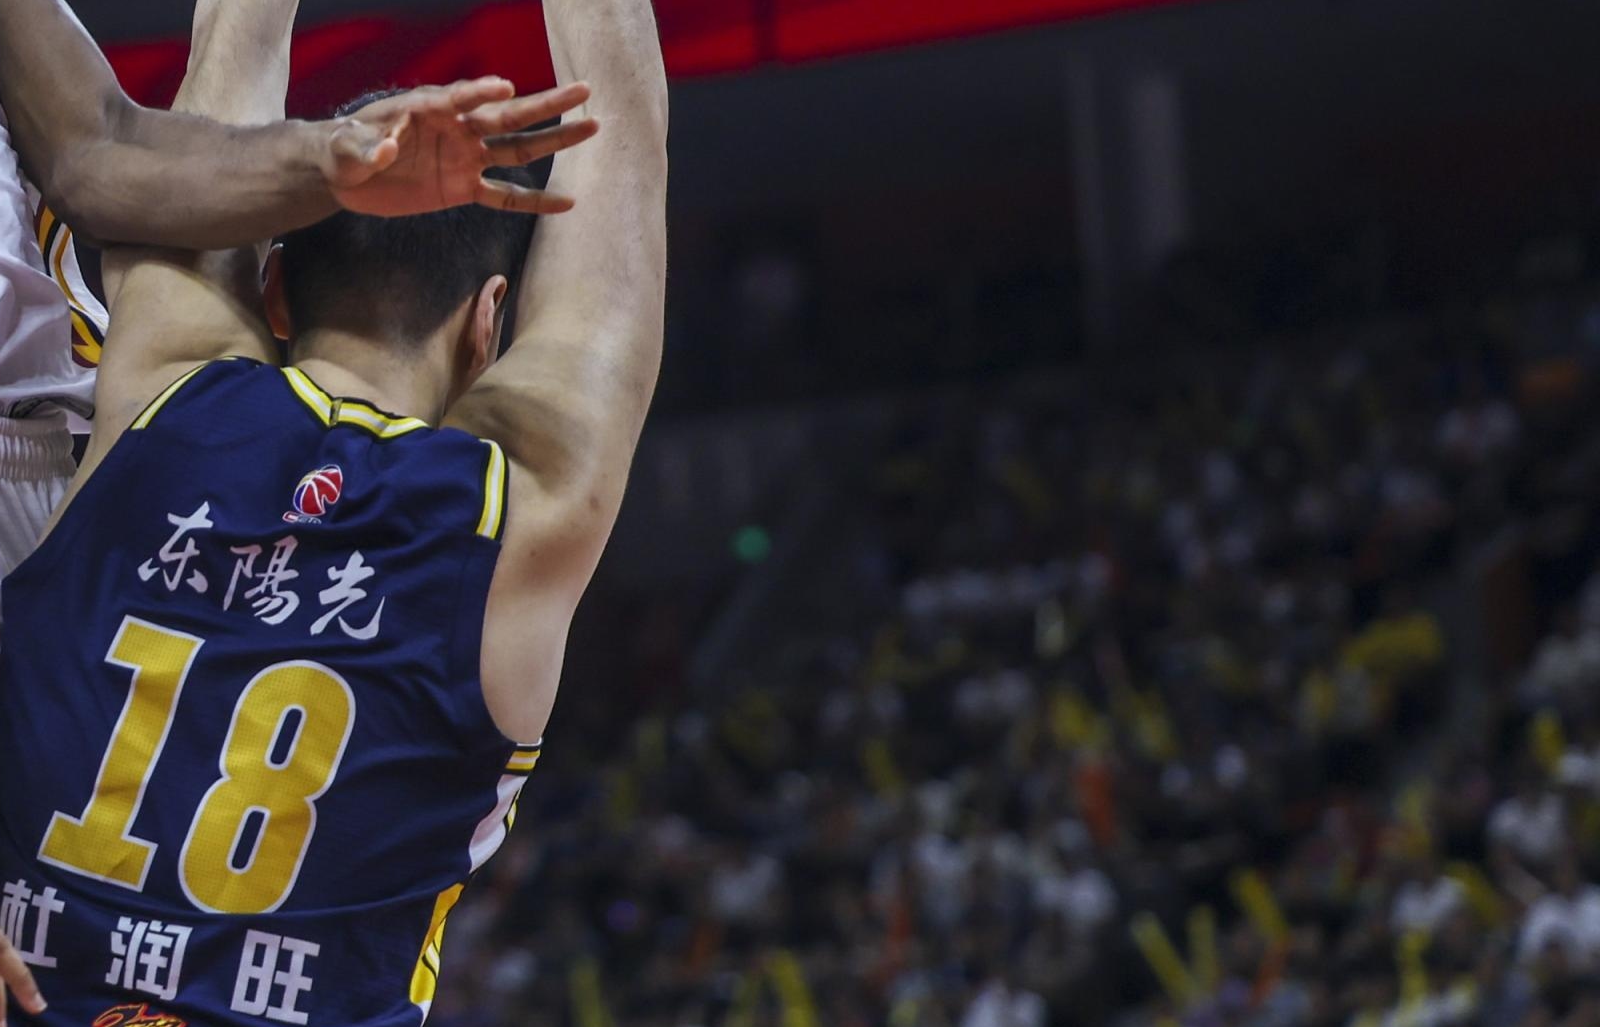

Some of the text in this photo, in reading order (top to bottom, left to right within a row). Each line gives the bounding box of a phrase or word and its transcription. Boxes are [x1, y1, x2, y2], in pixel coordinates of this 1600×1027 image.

[36, 614, 356, 915] 18
[0, 878, 321, 1026] 杜润旺
